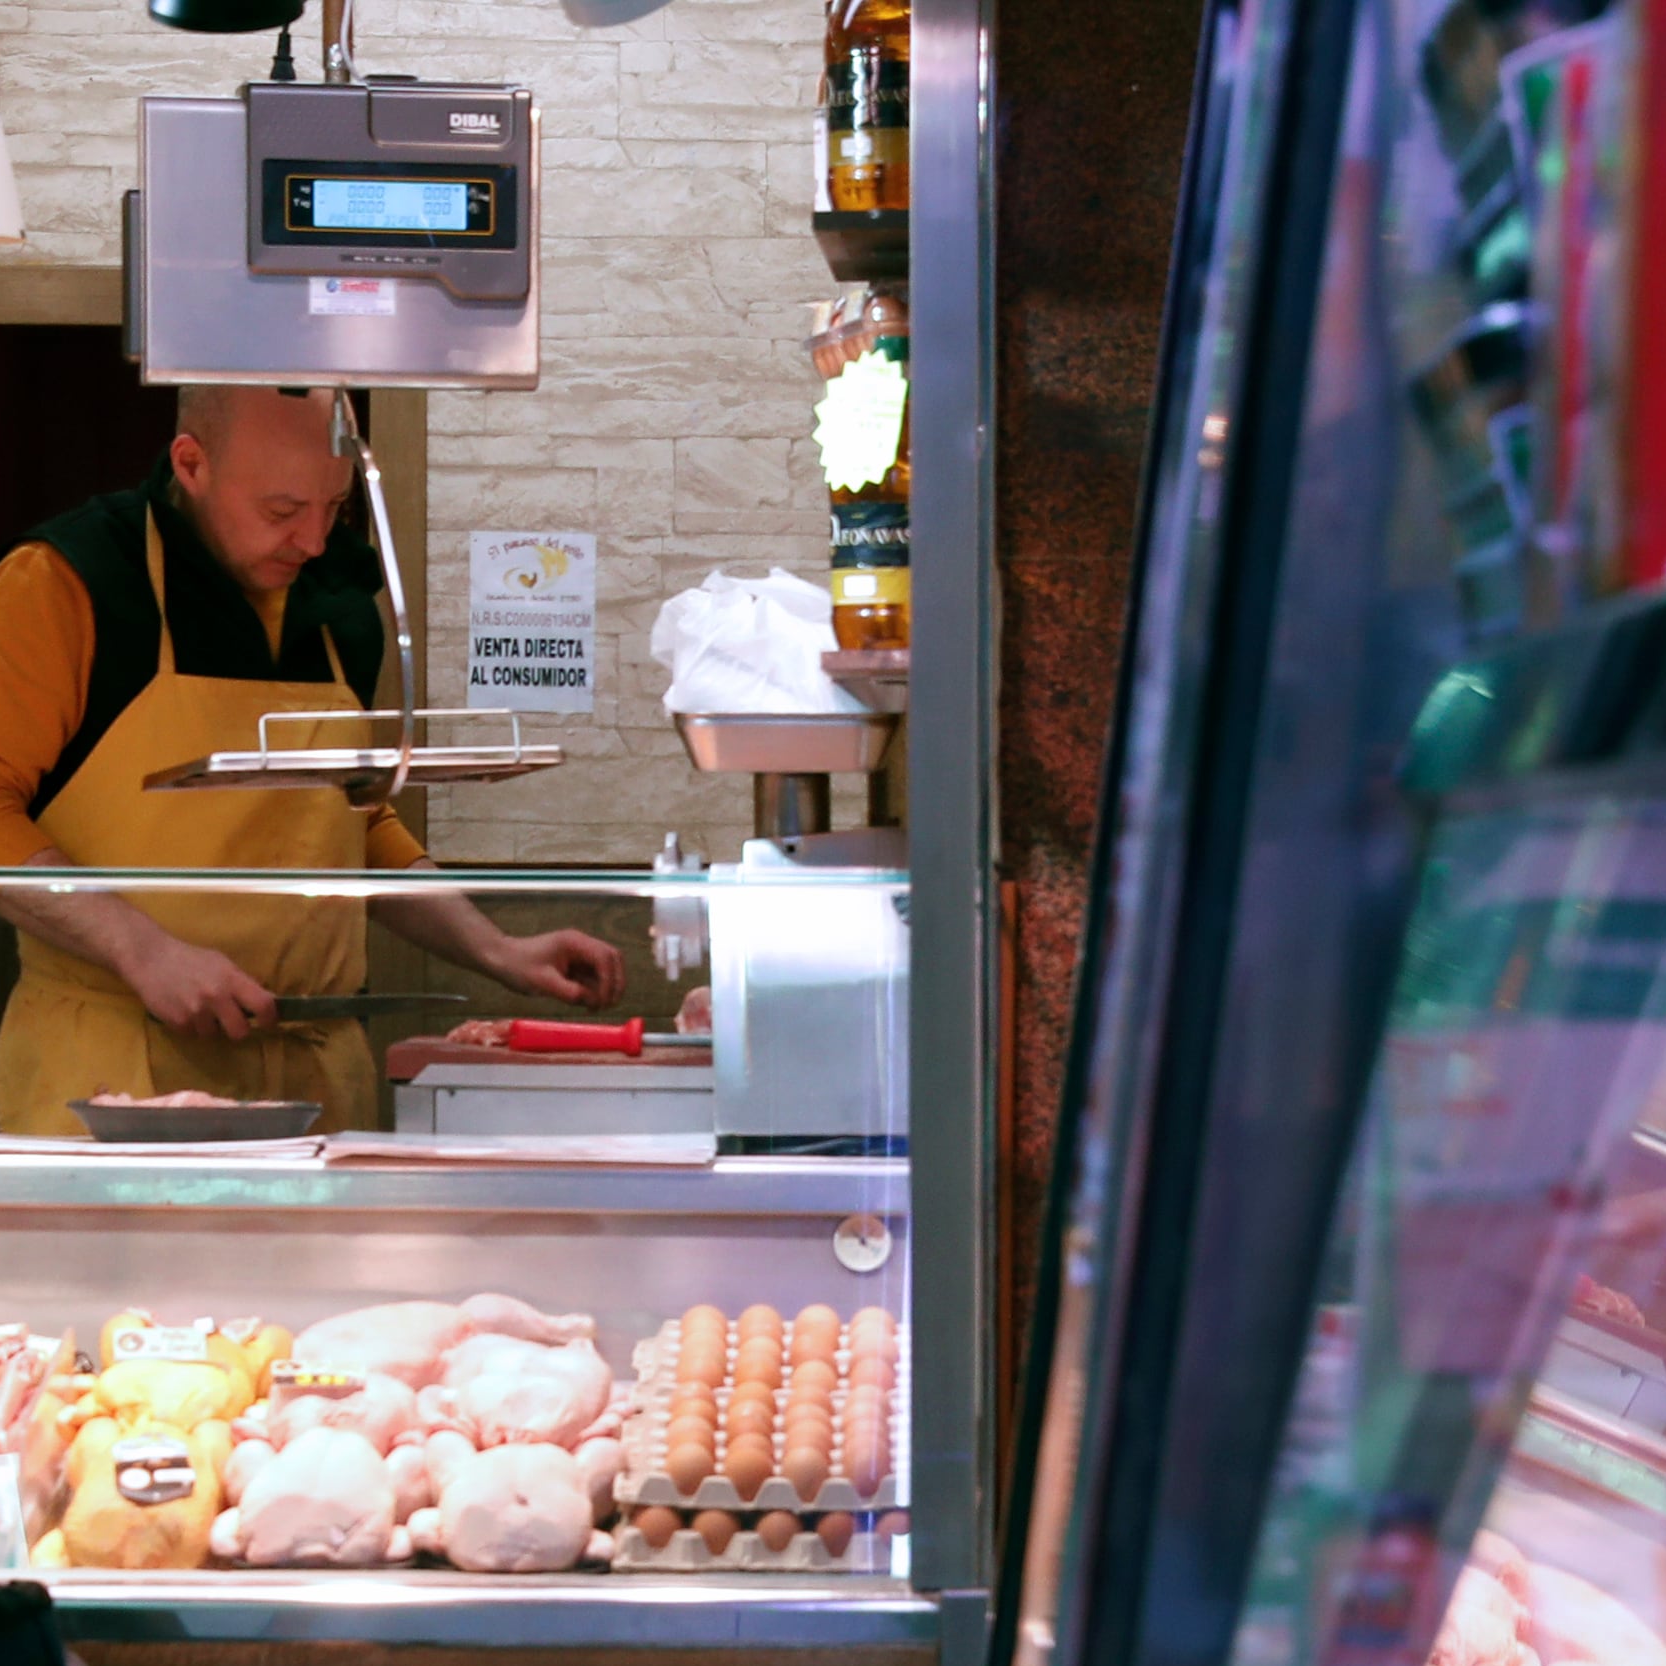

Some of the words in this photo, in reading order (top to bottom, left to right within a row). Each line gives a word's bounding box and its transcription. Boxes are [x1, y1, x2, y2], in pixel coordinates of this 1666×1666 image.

[449, 112, 501, 128] DIBAL
[474, 638, 520, 657] VENTA
[524, 639, 584, 659] DIRECTA
[470, 666, 488, 686] AL
[492, 667, 587, 687] CONSUMIDOR
